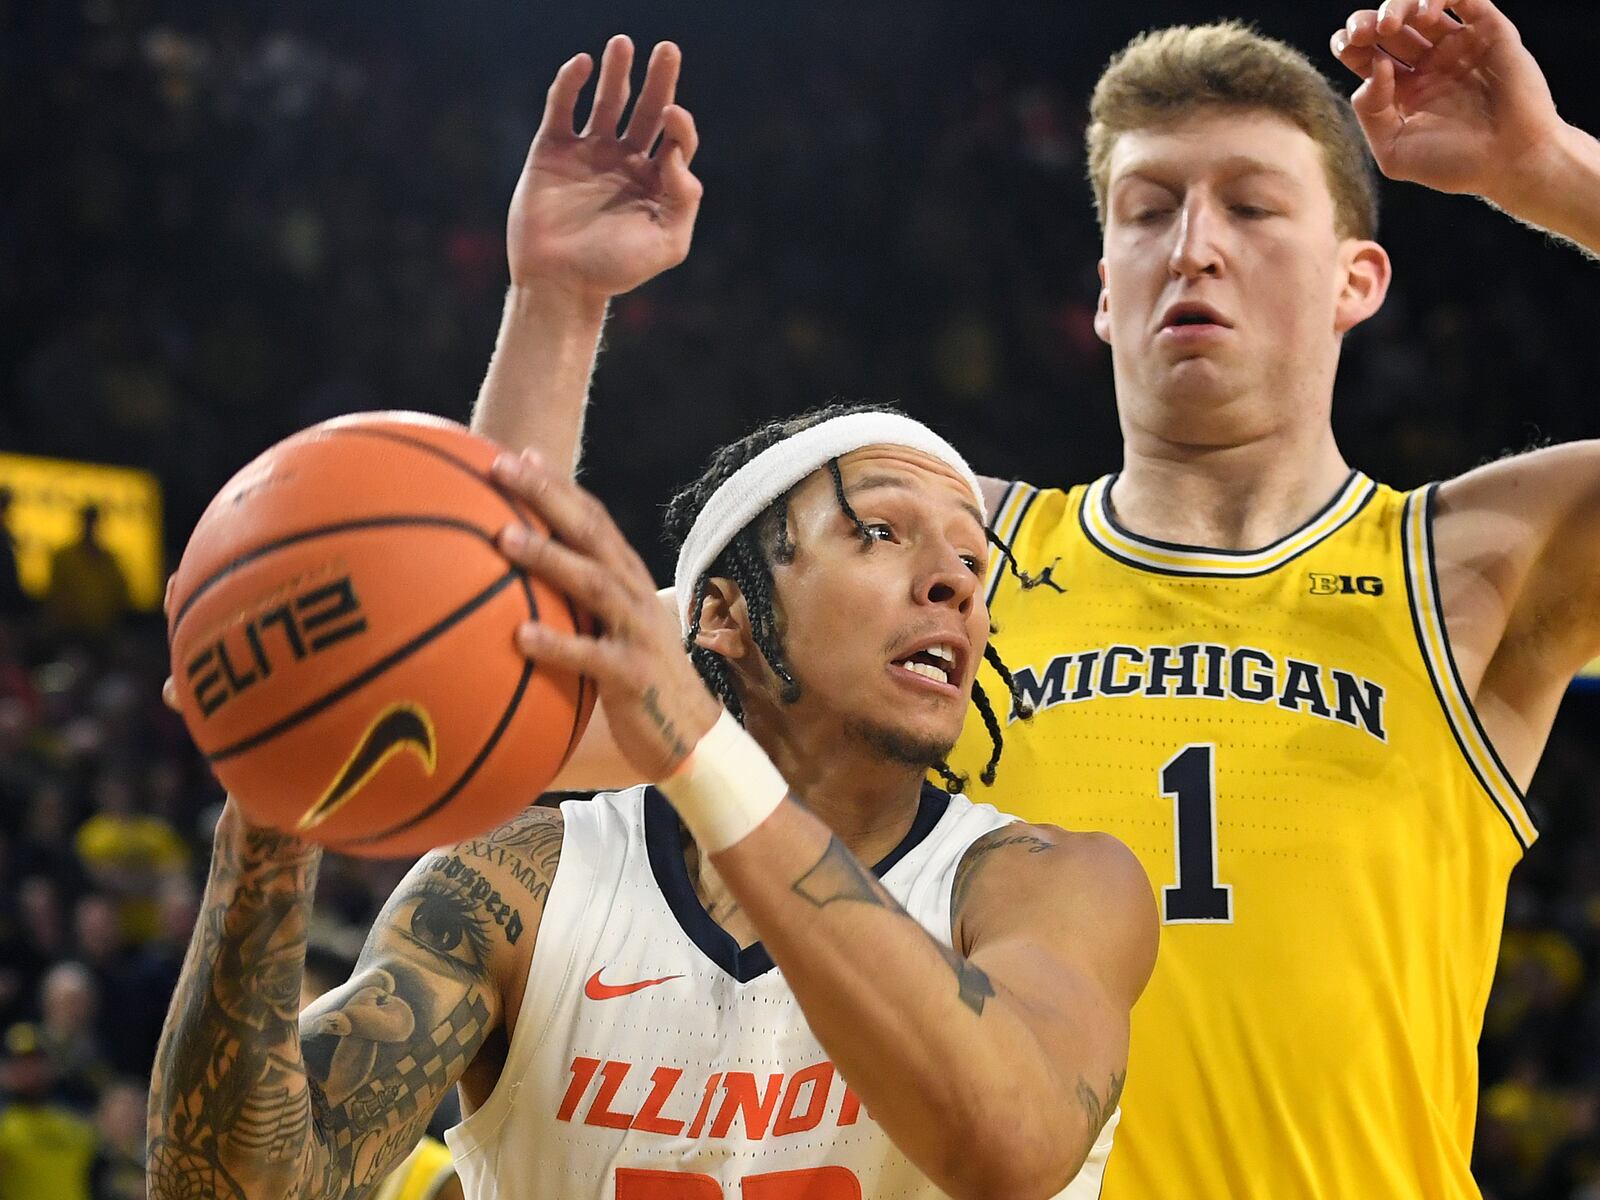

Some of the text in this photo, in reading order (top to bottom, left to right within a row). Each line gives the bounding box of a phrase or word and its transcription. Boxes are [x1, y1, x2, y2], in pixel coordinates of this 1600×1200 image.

[187, 576, 367, 717] ELITE
[1007, 643, 1389, 744] MICHIGAN
[1159, 743, 1233, 925] 1
